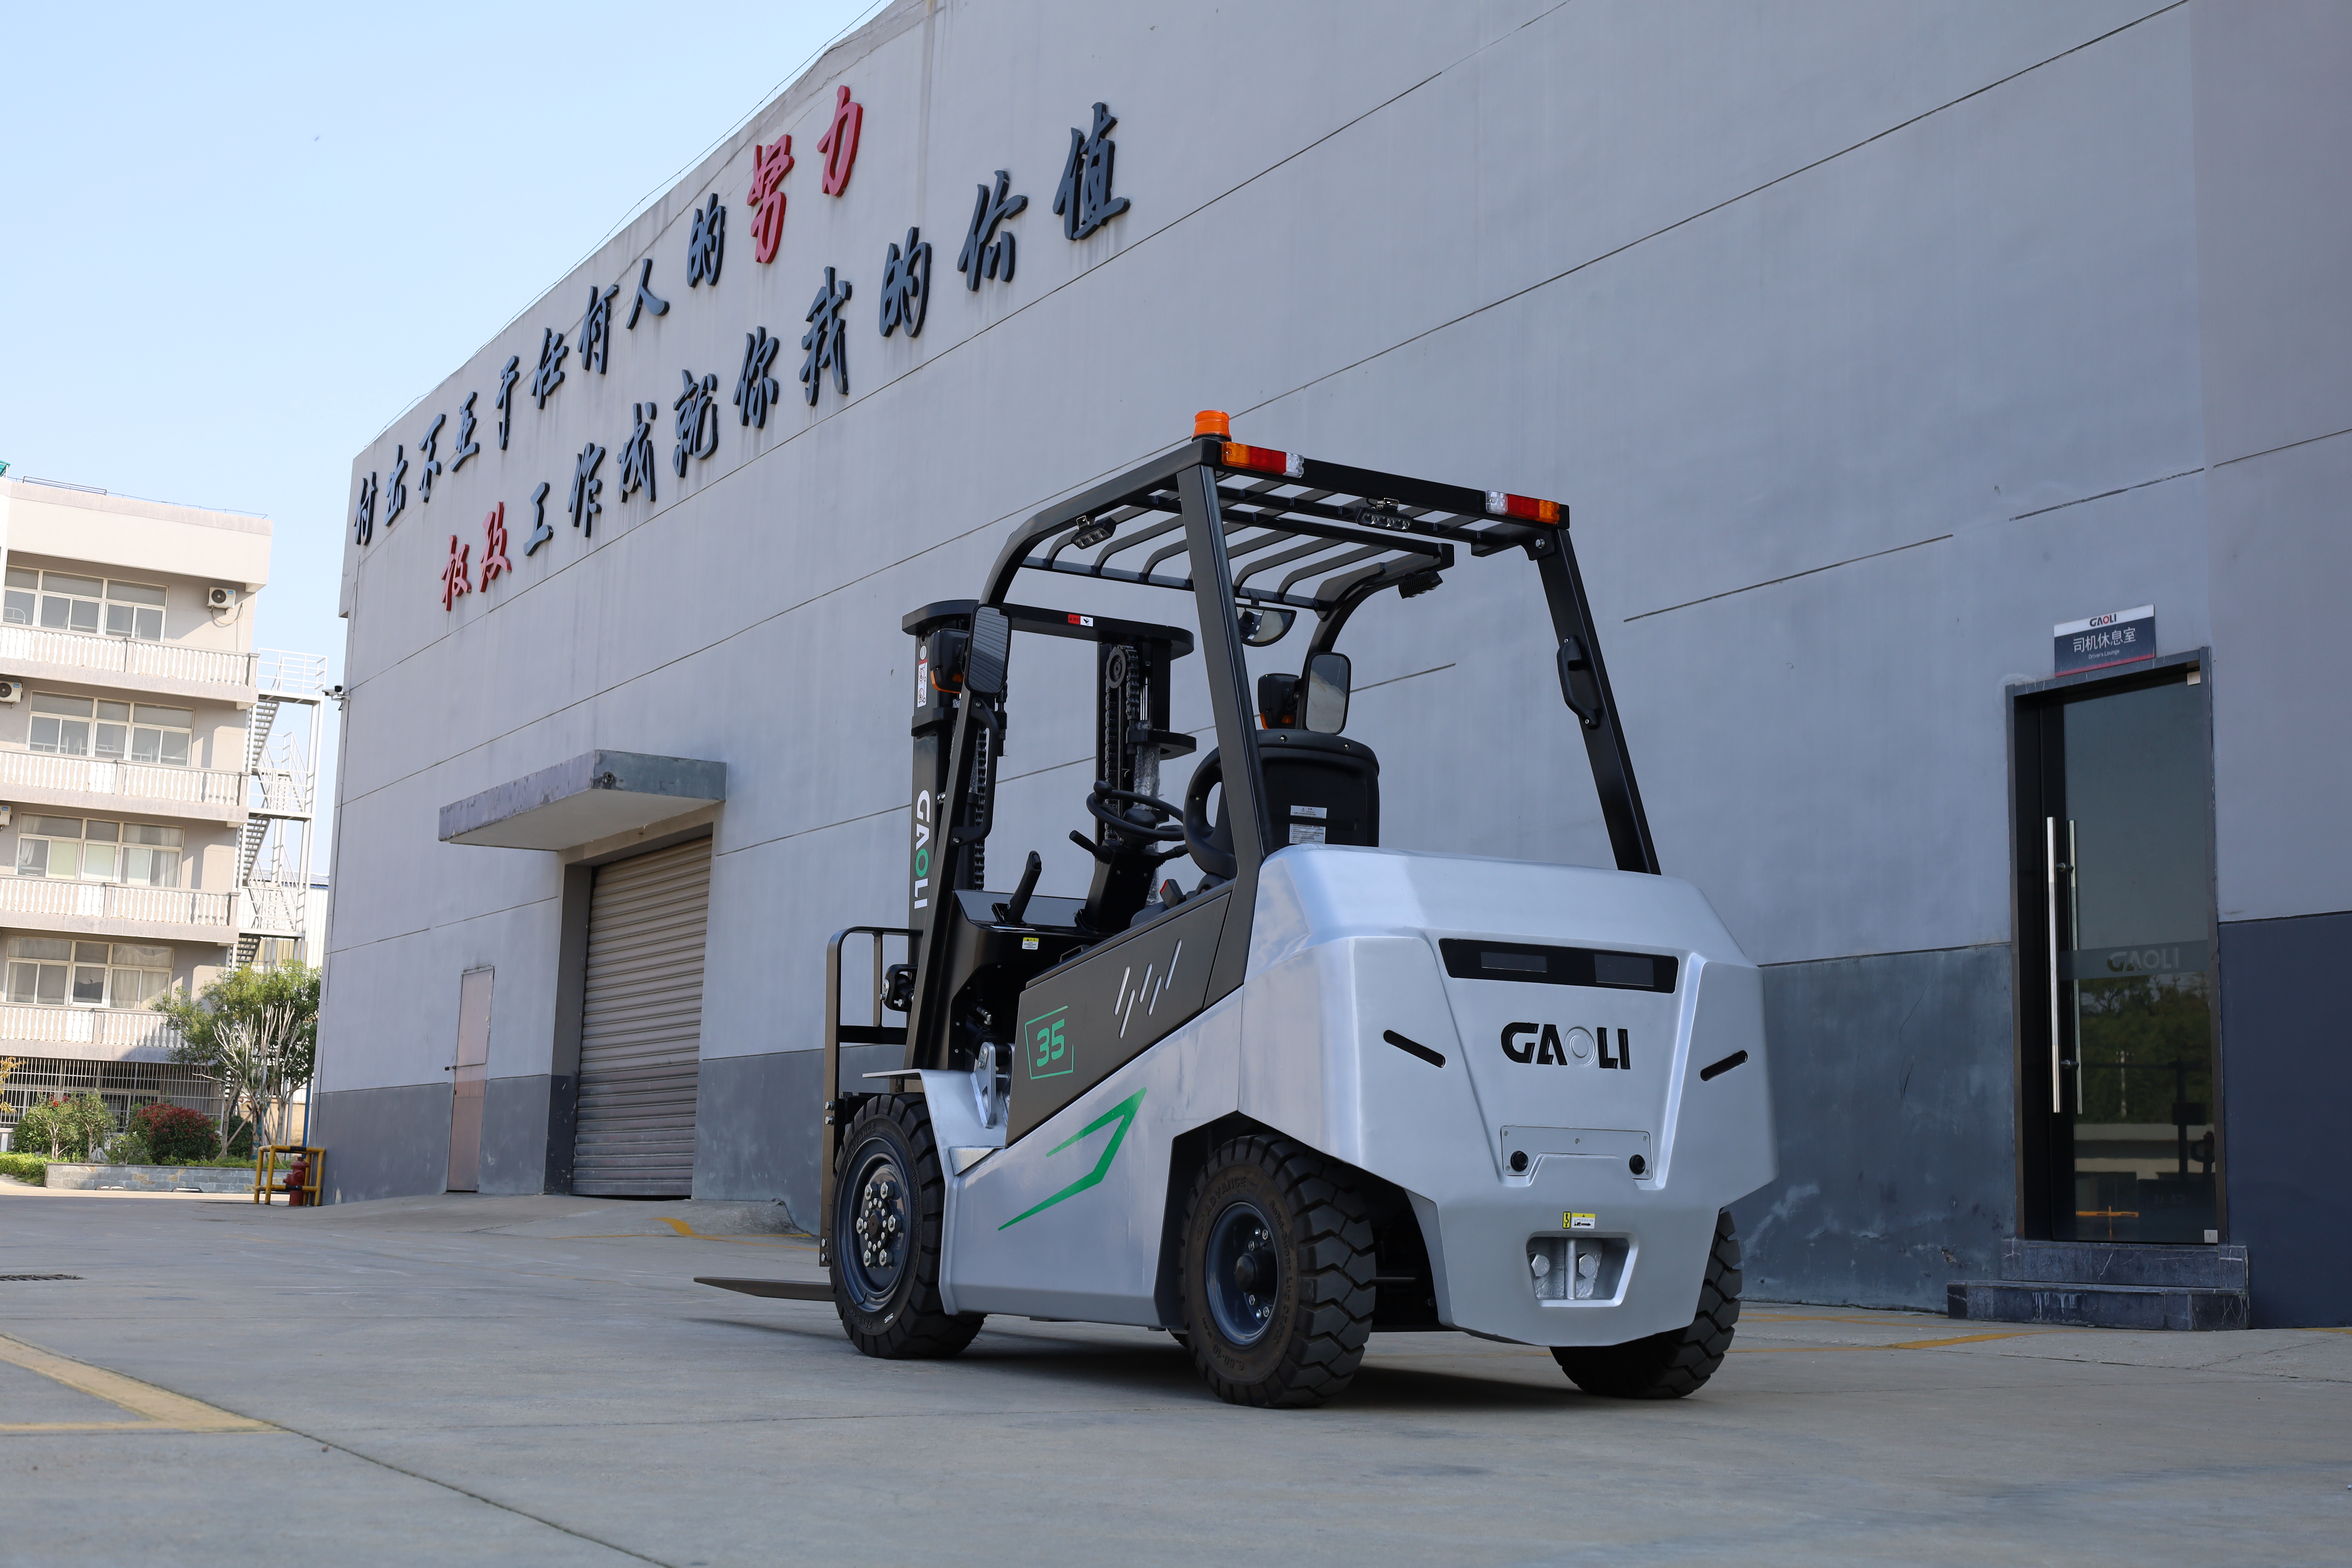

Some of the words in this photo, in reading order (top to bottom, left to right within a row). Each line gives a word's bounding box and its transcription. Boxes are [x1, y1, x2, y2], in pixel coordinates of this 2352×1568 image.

[2073, 627, 2136, 652] 司机休息室
[2089, 614, 2116, 627] GAOLI
[914, 789, 931, 909] GAOLI
[2107, 947, 2179, 972] GAOLI
[1037, 1018, 1065, 1067] 35
[1501, 1022, 1631, 1070] GAOLI
[847, 1122, 876, 1164] ADVANCE
[1205, 1176, 1247, 1217] ADVANCE
